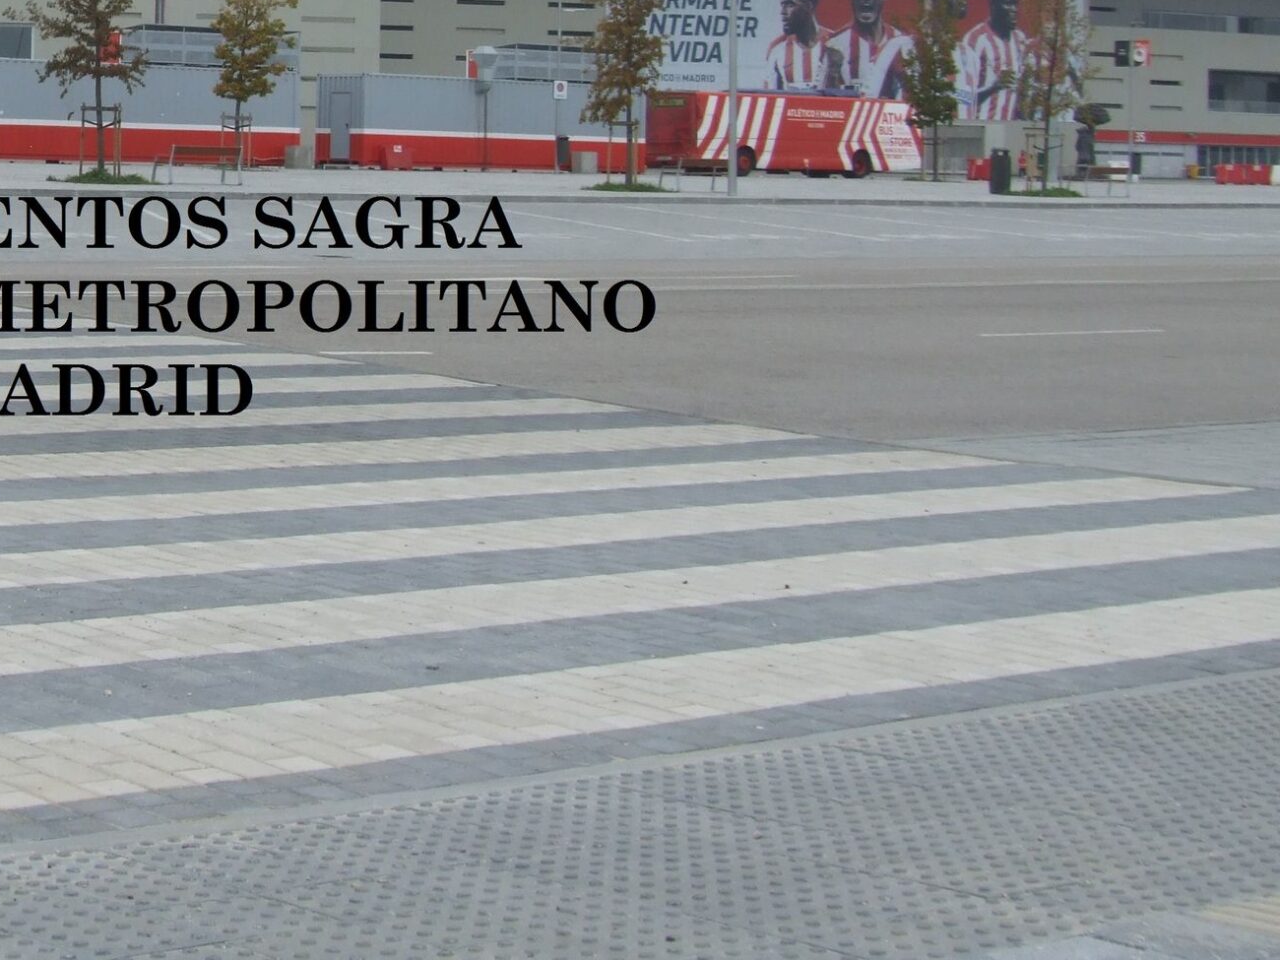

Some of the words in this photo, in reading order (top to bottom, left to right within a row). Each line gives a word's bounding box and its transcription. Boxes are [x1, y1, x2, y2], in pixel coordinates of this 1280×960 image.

[648, 13, 758, 38] NTENDER
[669, 41, 722, 63] VIDA
[682, 74, 716, 83] MADRID
